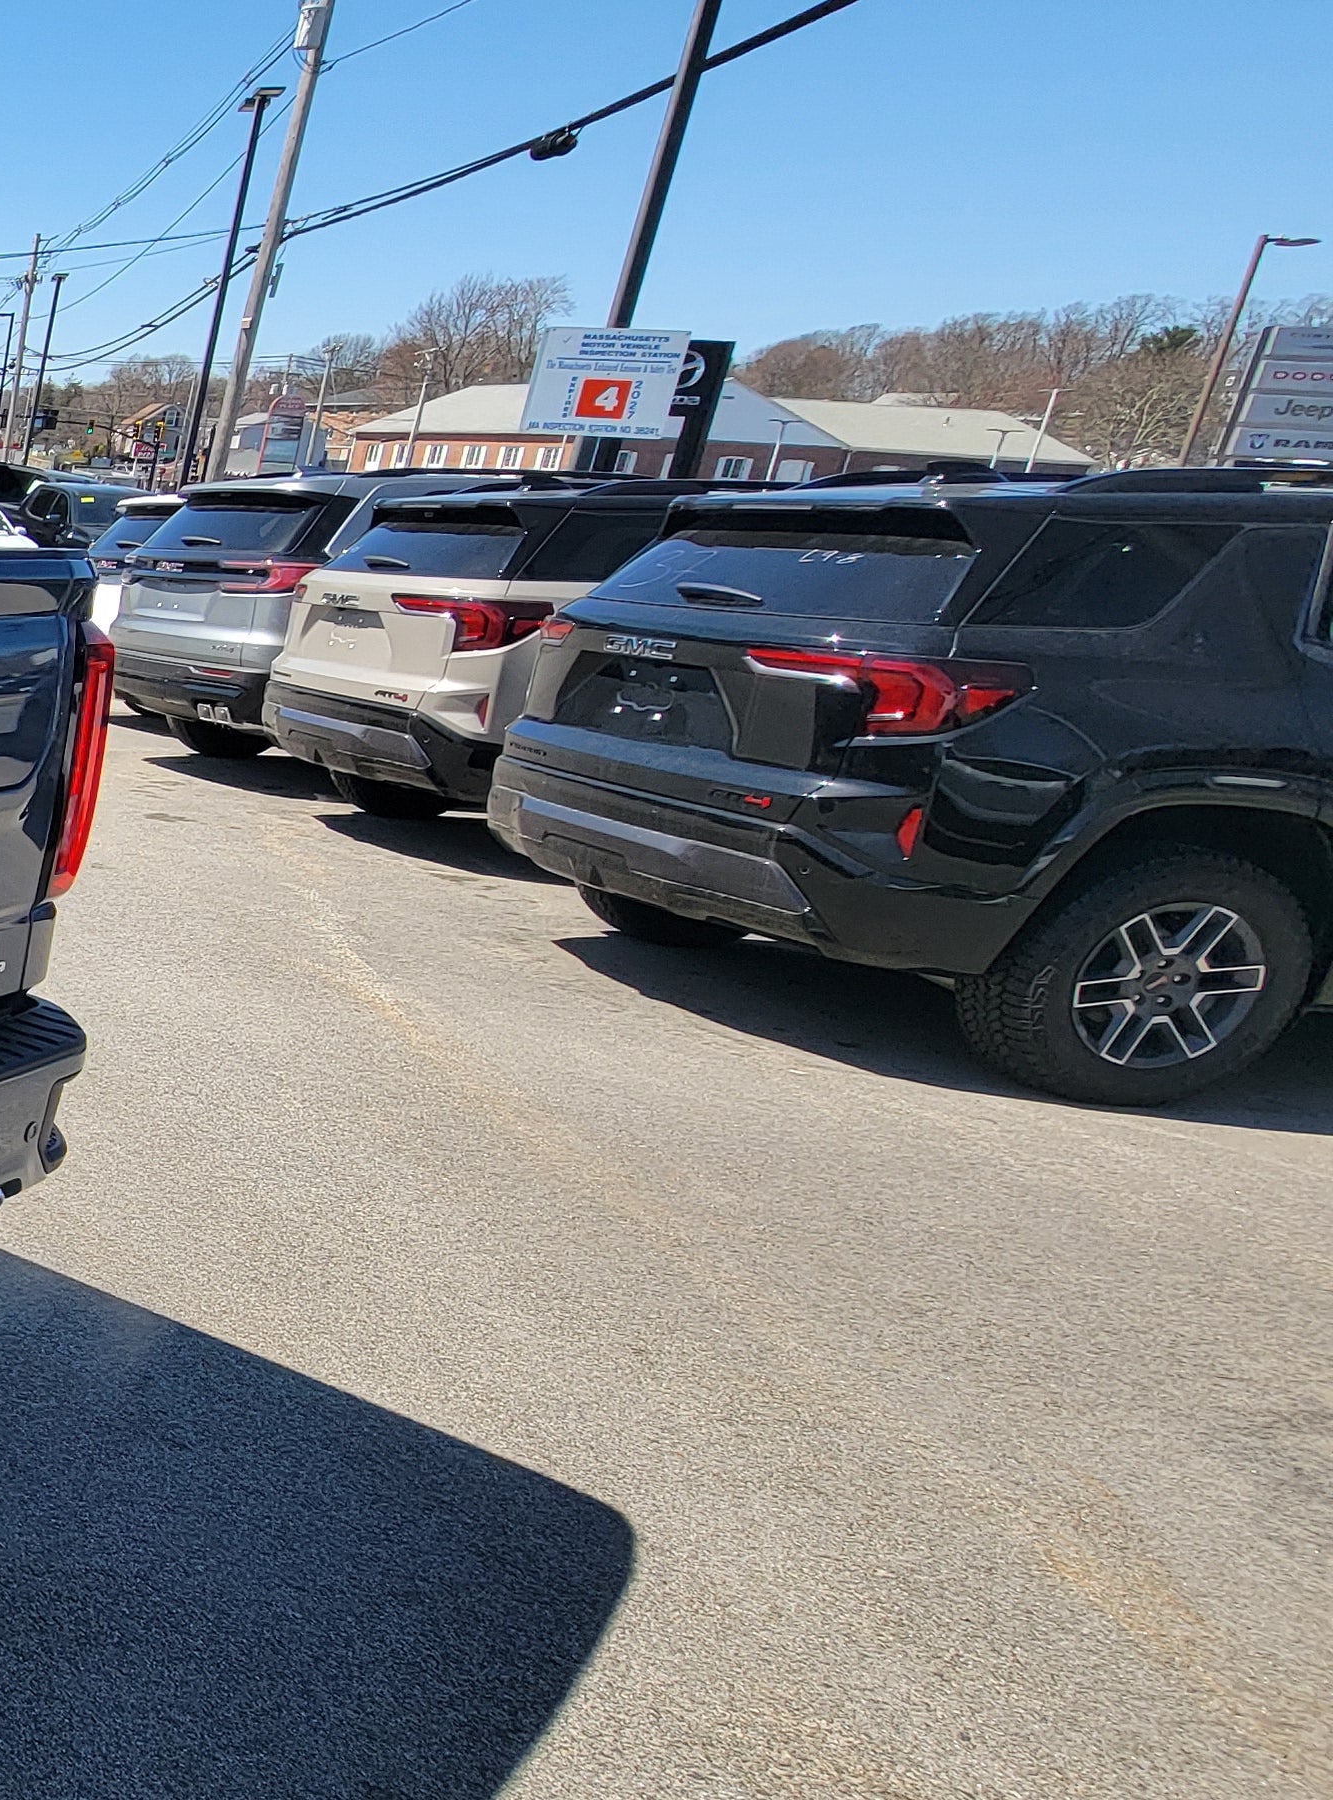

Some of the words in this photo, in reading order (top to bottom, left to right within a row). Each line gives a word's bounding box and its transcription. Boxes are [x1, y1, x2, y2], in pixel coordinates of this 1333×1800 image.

[582, 333, 670, 343] MASSACHUSETTS
[580, 341, 615, 349] MOTOR
[620, 342, 661, 350] VEHICLE
[578, 349, 636, 357] INSPECTION
[640, 351, 681, 359] STATION
[1274, 371, 1333, 381] DOD
[594, 386, 620, 411] 4
[627, 380, 643, 420] 2027
[1274, 399, 1333, 421] Jeep
[1274, 439, 1333, 450] RAM
[320, 592, 360, 608] GMC
[603, 634, 678, 660] GMC
